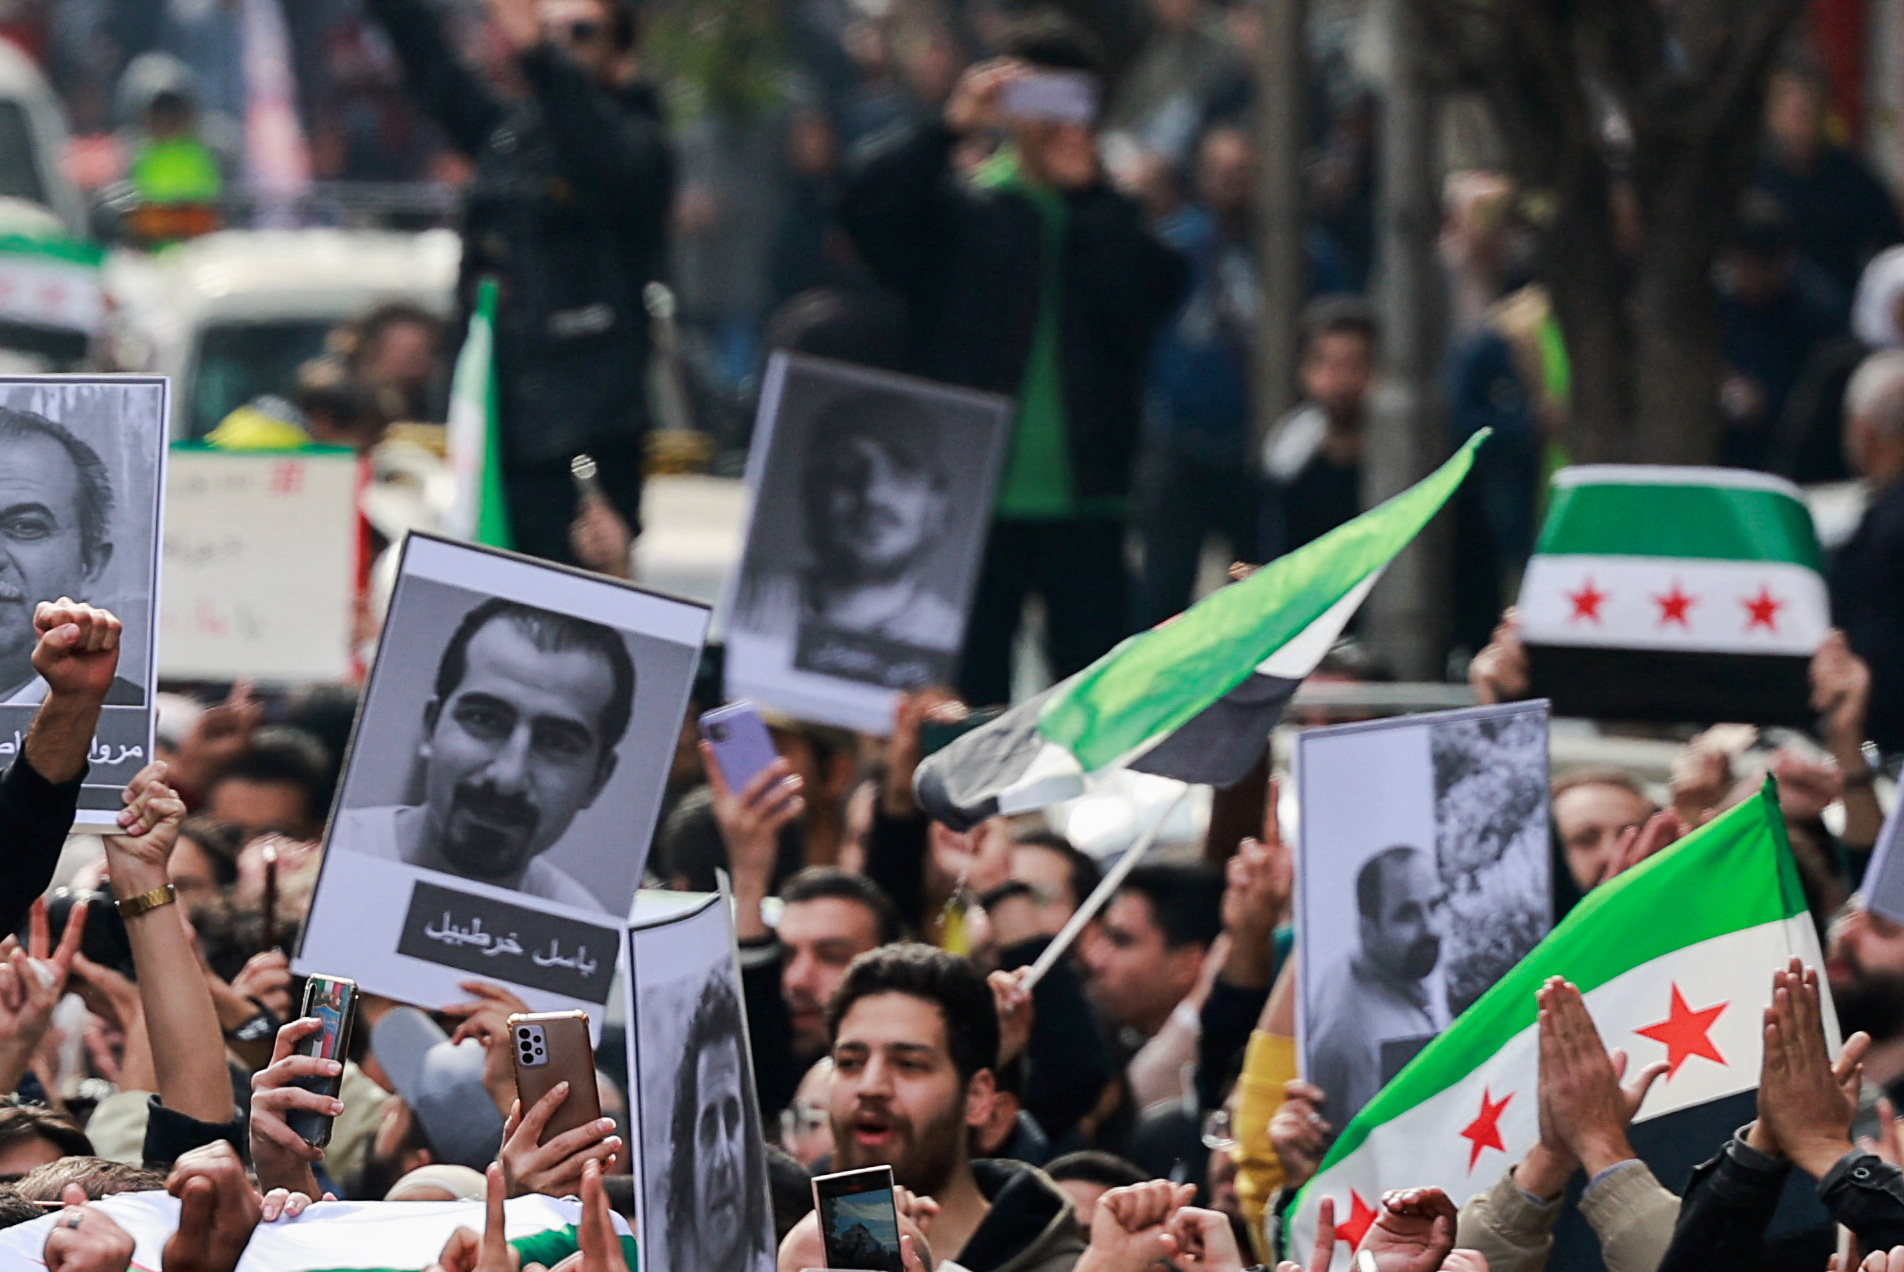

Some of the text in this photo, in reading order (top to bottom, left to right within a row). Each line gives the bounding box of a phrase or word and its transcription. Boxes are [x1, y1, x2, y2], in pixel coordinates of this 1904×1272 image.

[87, 734, 144, 764] مروا
[423, 910, 598, 978] باسل خرطبيل
